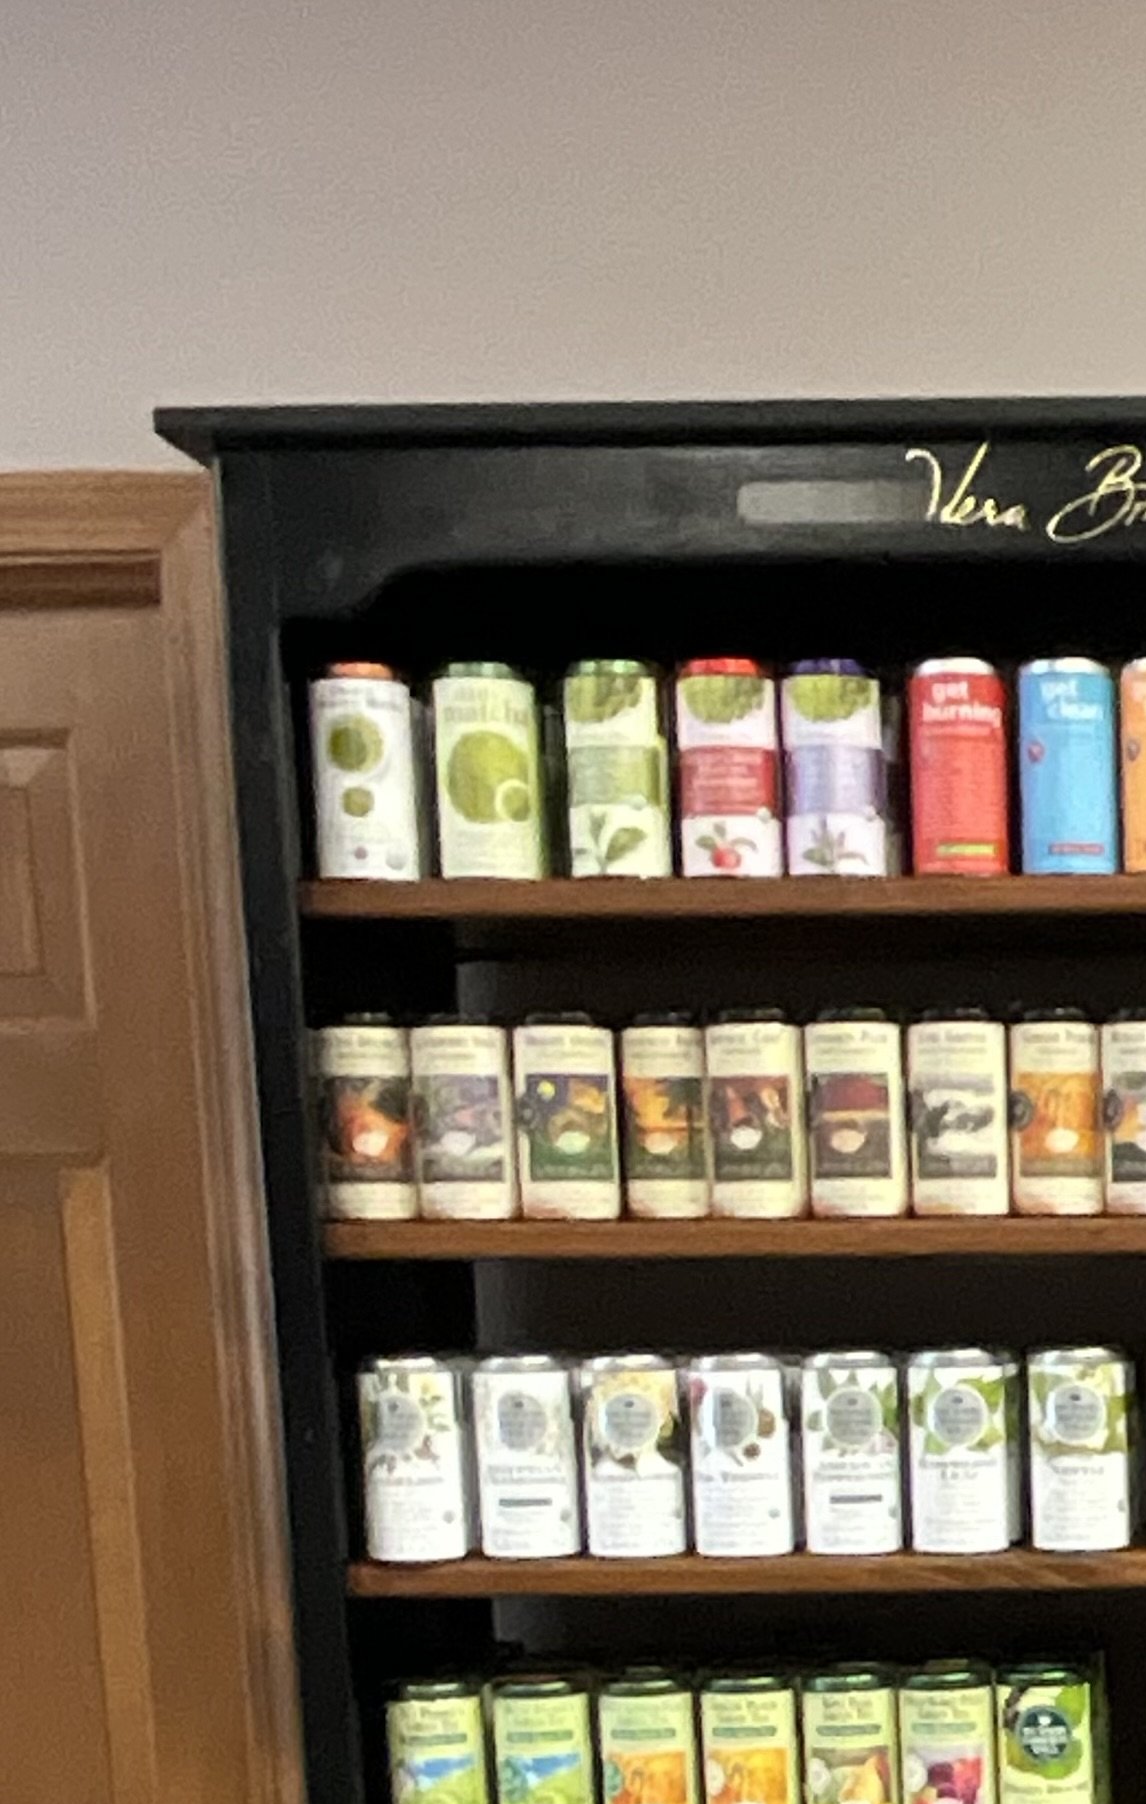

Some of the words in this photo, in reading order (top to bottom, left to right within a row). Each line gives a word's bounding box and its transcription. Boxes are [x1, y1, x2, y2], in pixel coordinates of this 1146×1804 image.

[905, 441, 1029, 530] Vera
[932, 681, 969, 703] get
[1040, 680, 1077, 703] get
[922, 700, 1003, 728] burning
